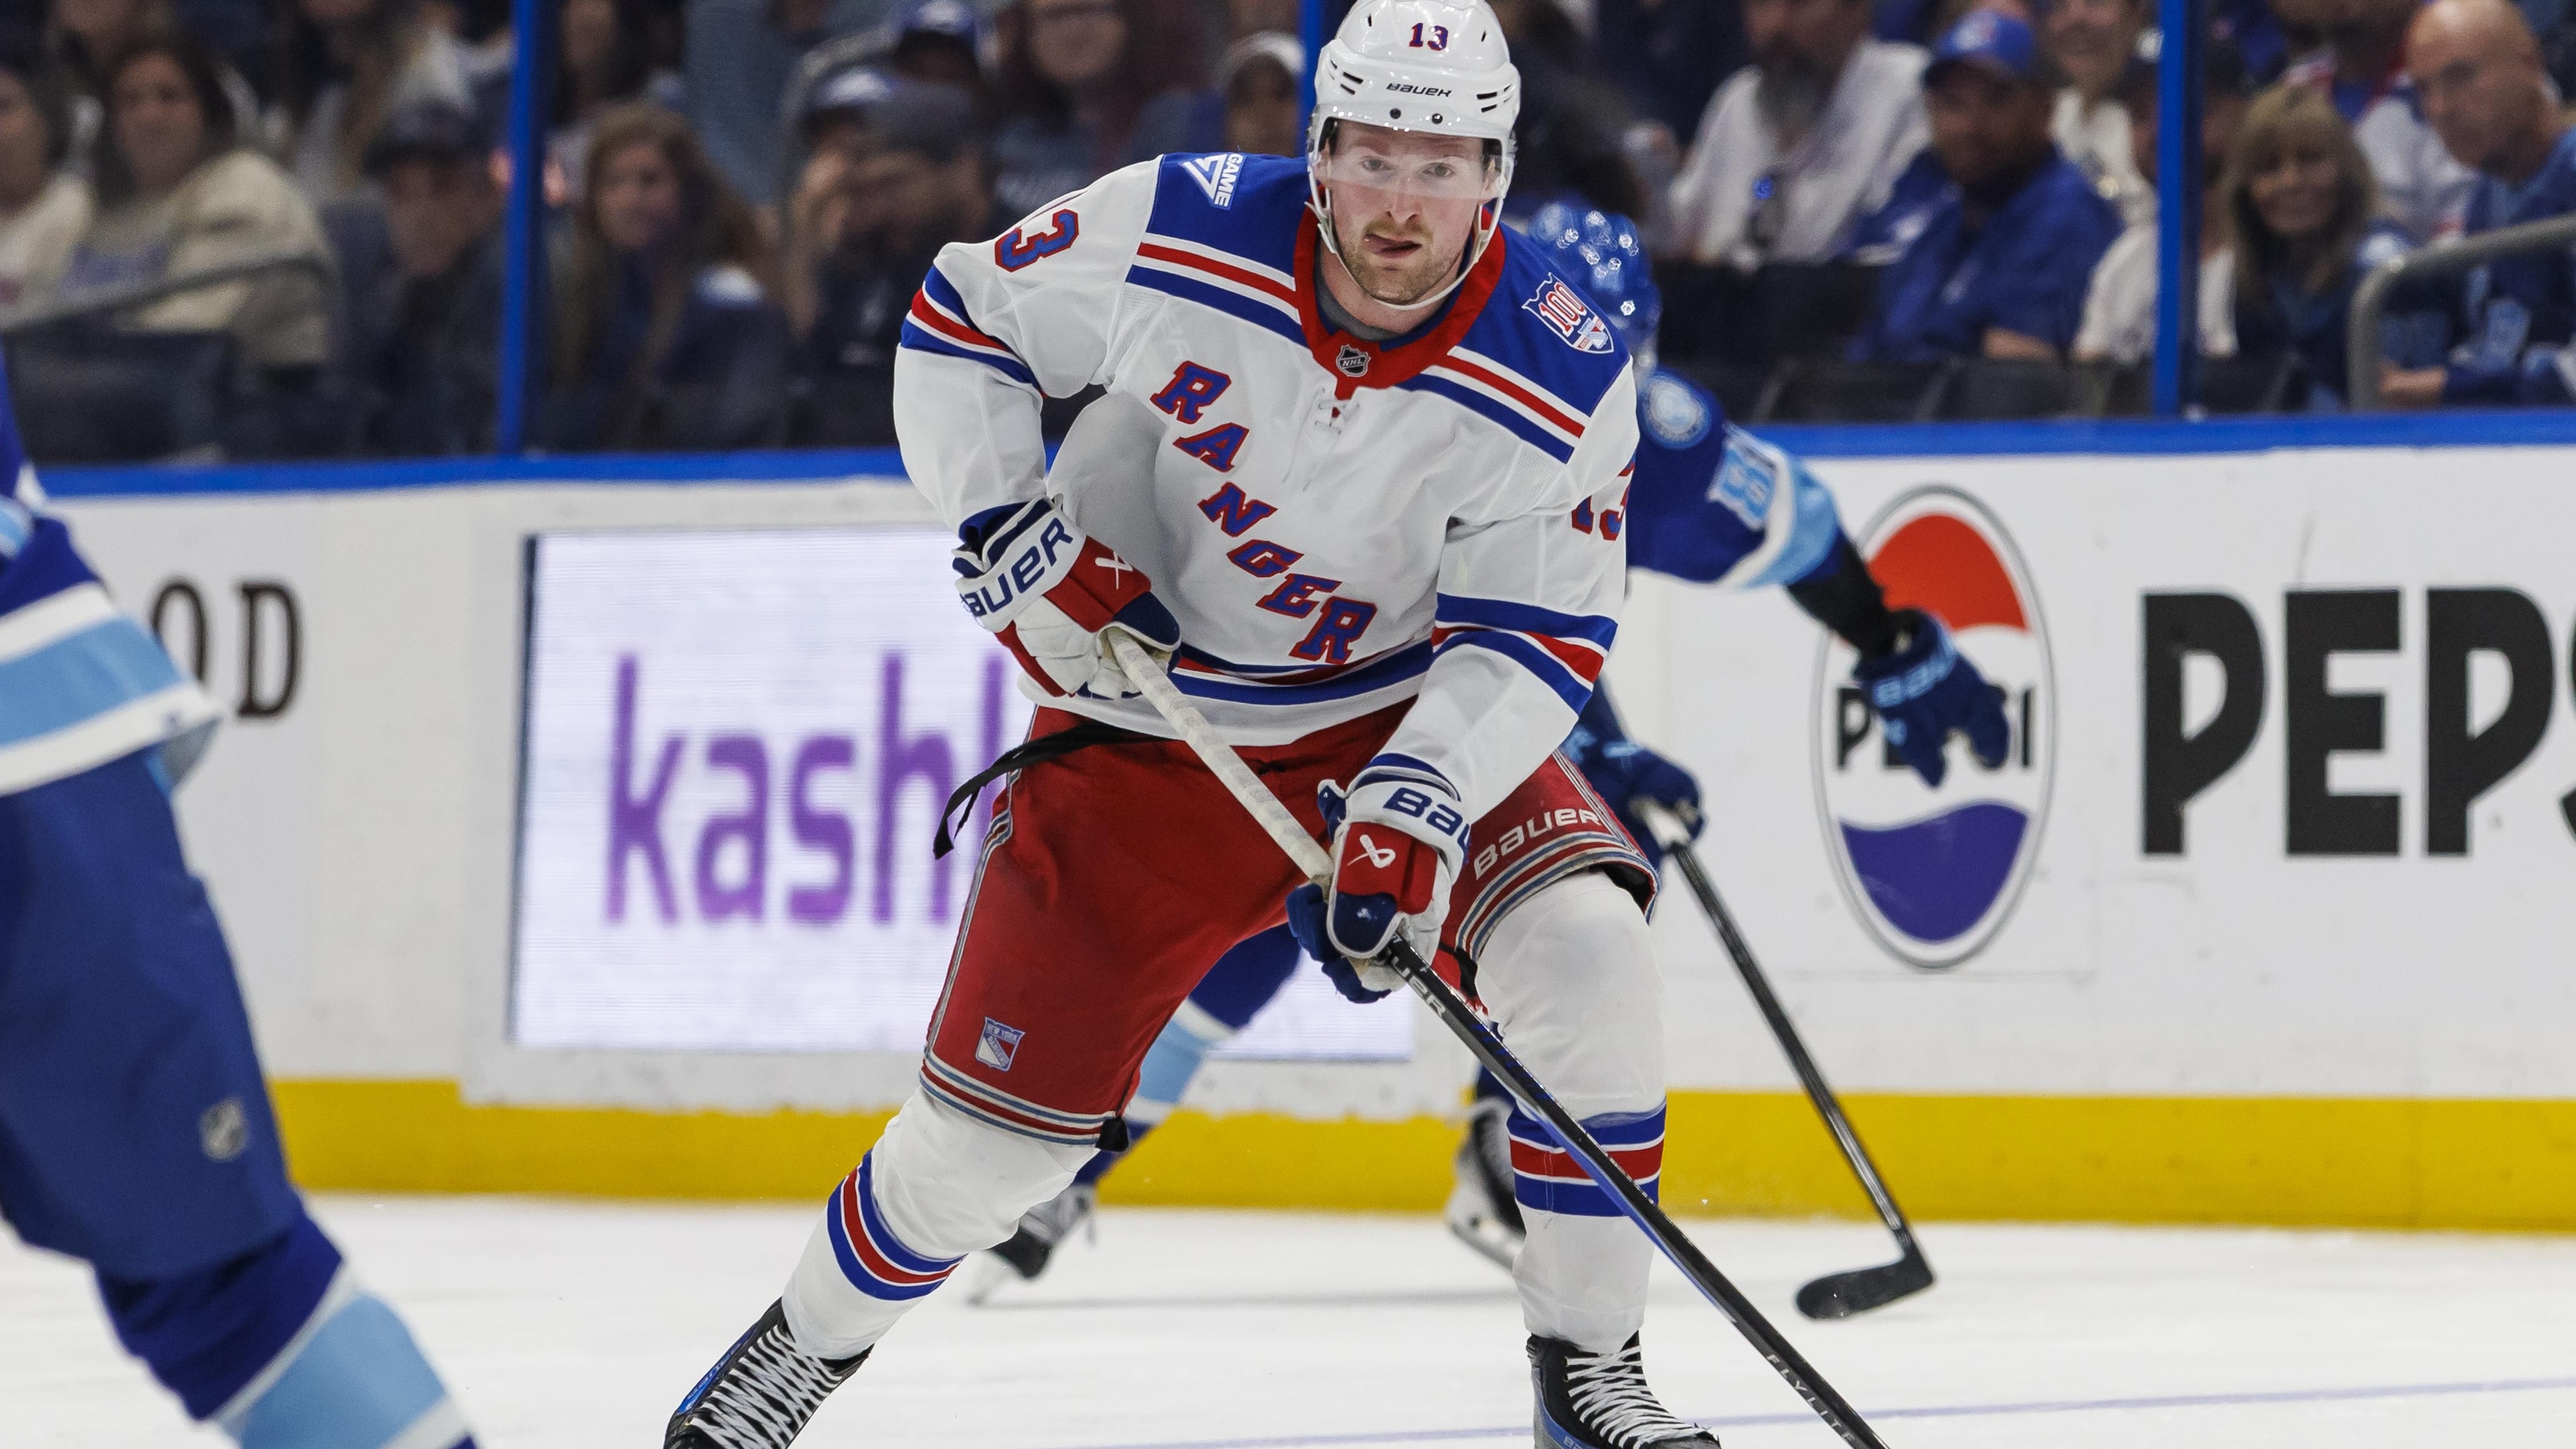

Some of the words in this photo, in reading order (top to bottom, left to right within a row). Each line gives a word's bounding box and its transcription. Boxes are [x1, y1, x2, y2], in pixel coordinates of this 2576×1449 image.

[1409, 23, 1449, 51] 13
[1214, 153, 1244, 207] GAME
[1538, 282, 1587, 337] 100
[1342, 358, 1364, 367] NHL
[961, 517, 1074, 617] AUER
[2142, 587, 2576, 857] PEP
[1391, 955, 1446, 1018] UER
[1766, 1354, 1856, 1442] FLYLITE
